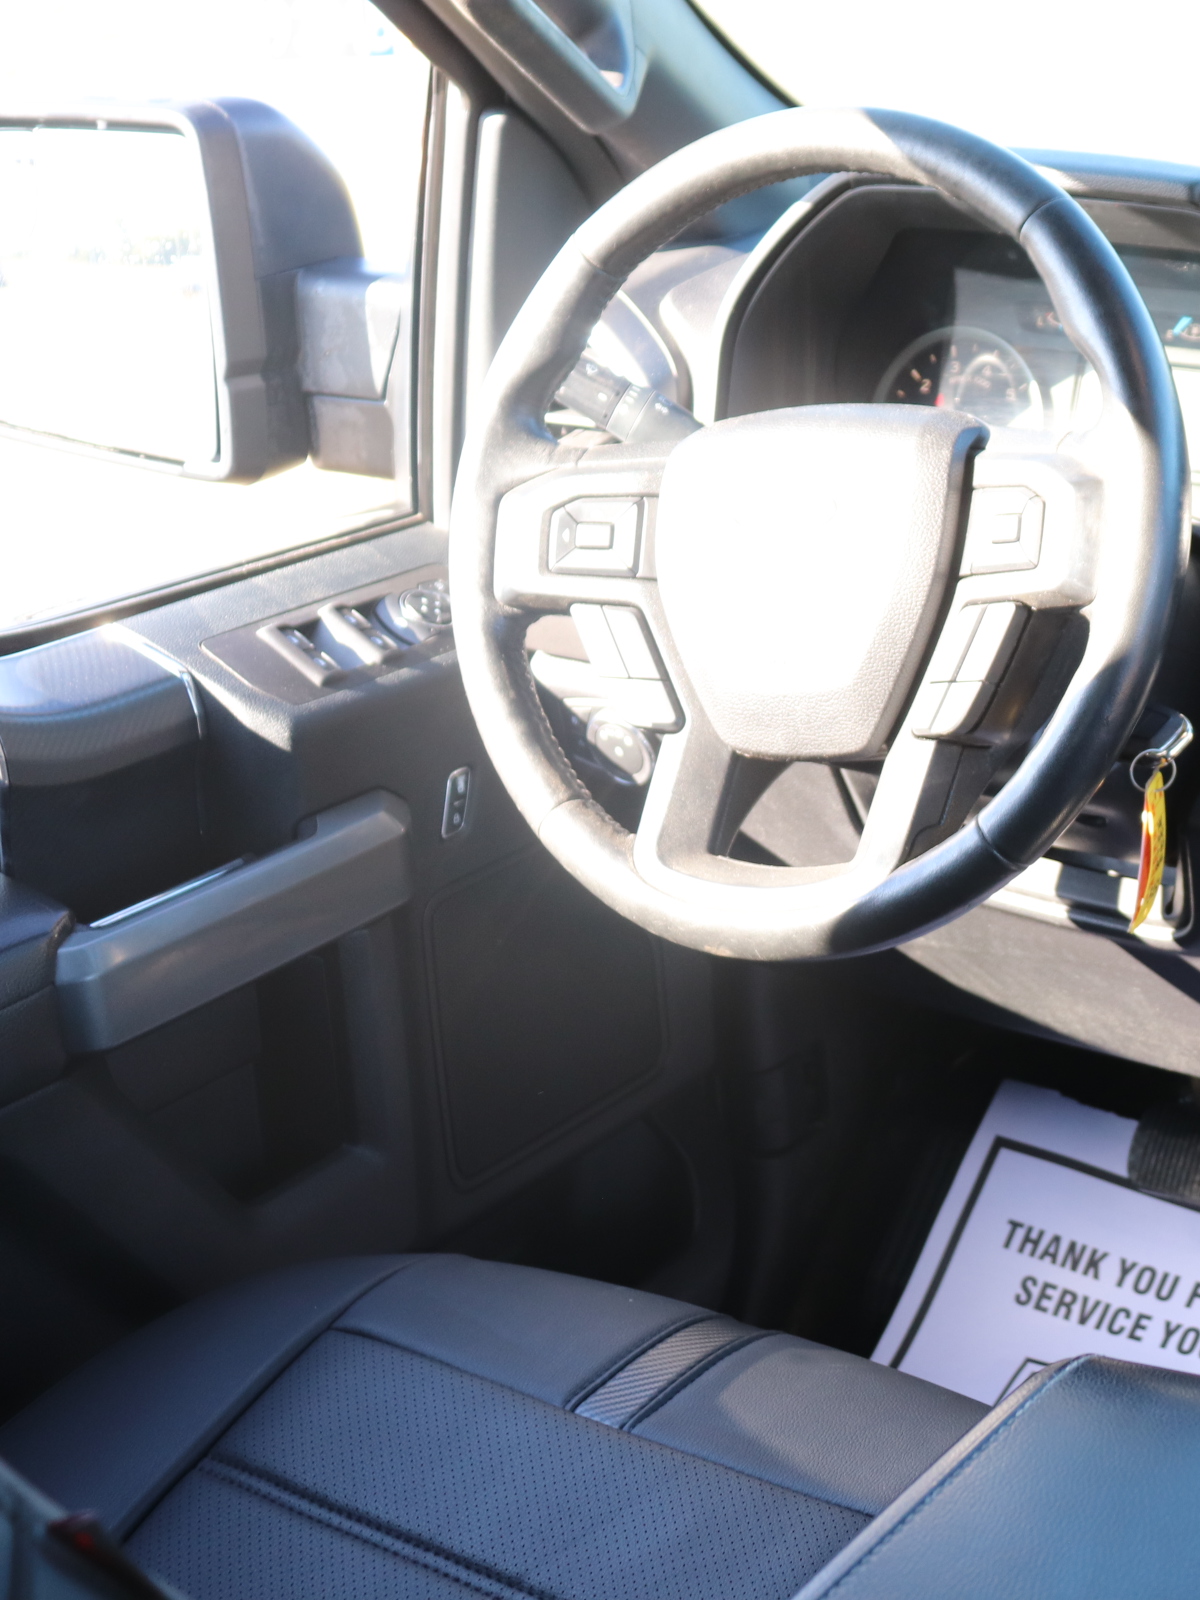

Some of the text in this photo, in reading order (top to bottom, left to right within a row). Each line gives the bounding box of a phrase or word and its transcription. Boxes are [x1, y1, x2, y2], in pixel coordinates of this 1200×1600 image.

[919, 379, 932, 394] 2
[1003, 1218, 1110, 1280] THANK
[1116, 1257, 1181, 1302] YOU
[1014, 1274, 1153, 1342] SERVICE
